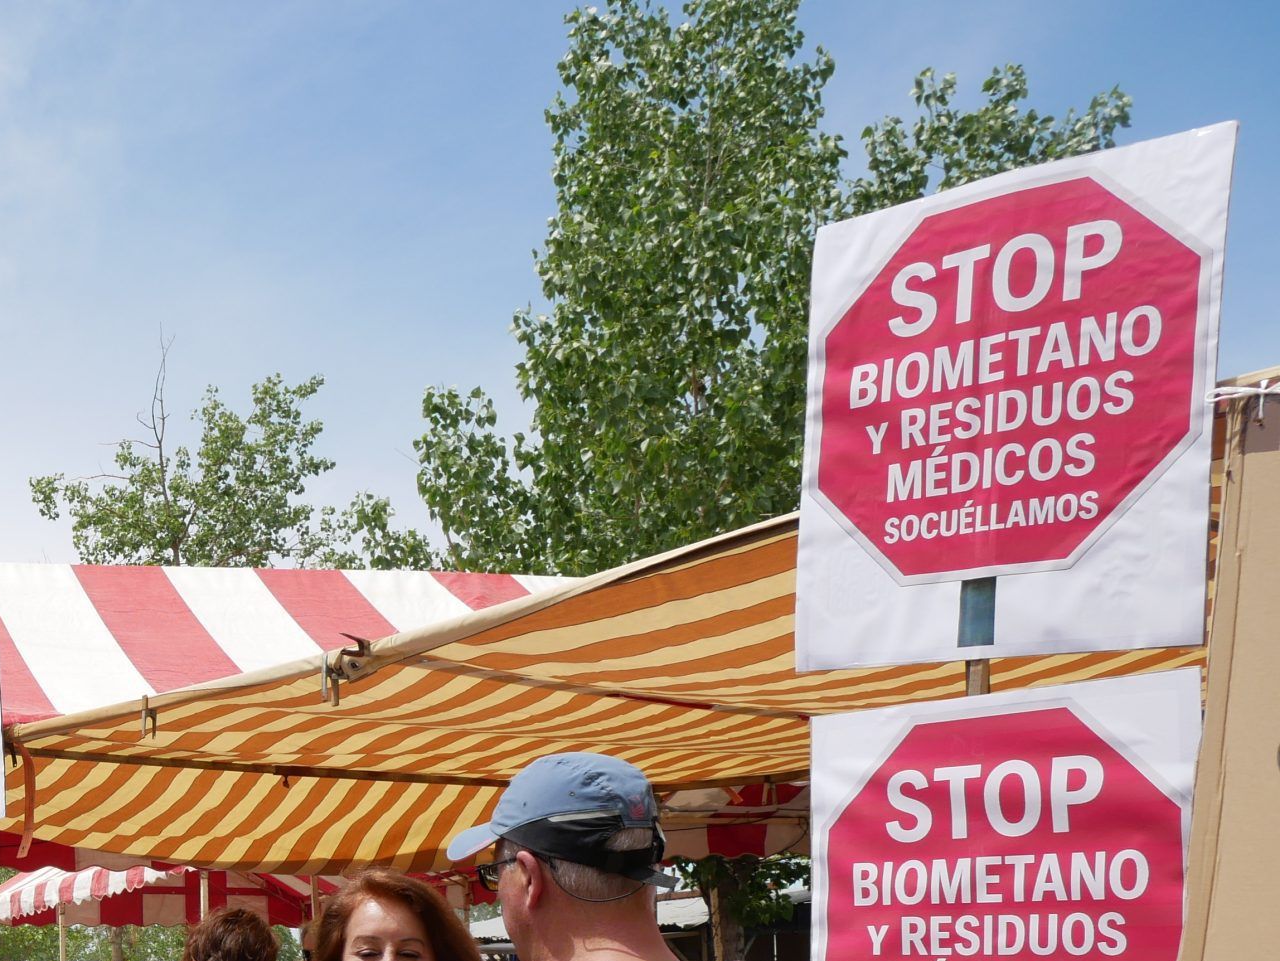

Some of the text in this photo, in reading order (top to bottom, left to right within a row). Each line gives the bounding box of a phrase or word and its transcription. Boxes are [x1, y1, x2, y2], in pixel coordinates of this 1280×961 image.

[888, 219, 1123, 338] STOP
[849, 304, 1163, 409] BIOMETANO
[865, 369, 1134, 455] Y RESIDUOS
[886, 432, 1096, 503] MÉDICOS
[884, 491, 1099, 544] SOCUÉLLAMOS
[885, 755, 1104, 843] STOP
[852, 849, 1150, 907] BIOMETANO
[867, 911, 1127, 957] Y RESIDUOS
